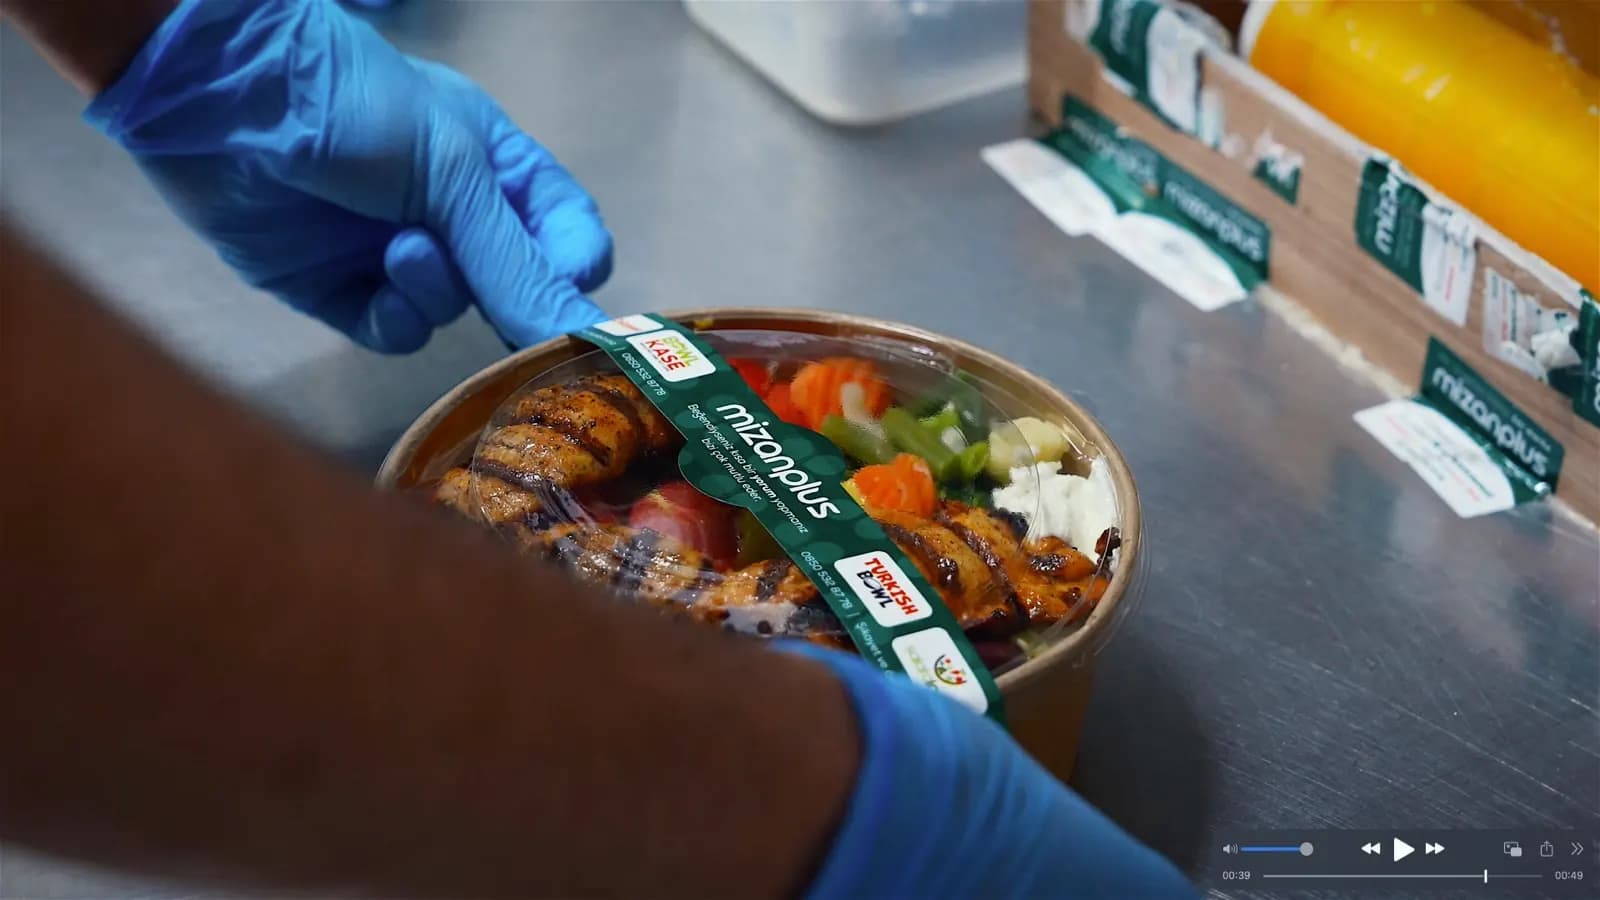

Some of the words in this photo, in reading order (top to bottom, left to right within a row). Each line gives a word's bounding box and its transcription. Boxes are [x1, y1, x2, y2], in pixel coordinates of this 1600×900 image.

[646, 339, 686, 371] KASE
[1432, 367, 1549, 475] mizanplus
[687, 403, 734, 450] Beğendiyseniz
[743, 463, 756, 475] bir
[750, 472, 777, 499] yorum
[773, 496, 808, 534] yapmanız
[716, 404, 841, 519] mizanplus
[723, 461, 746, 485] mutlu
[801, 551, 822, 571] 0850
[817, 570, 835, 587] 532
[865, 557, 919, 615] TURKISH
[857, 570, 893, 608] BOWL
[855, 621, 883, 657] Şikayet
